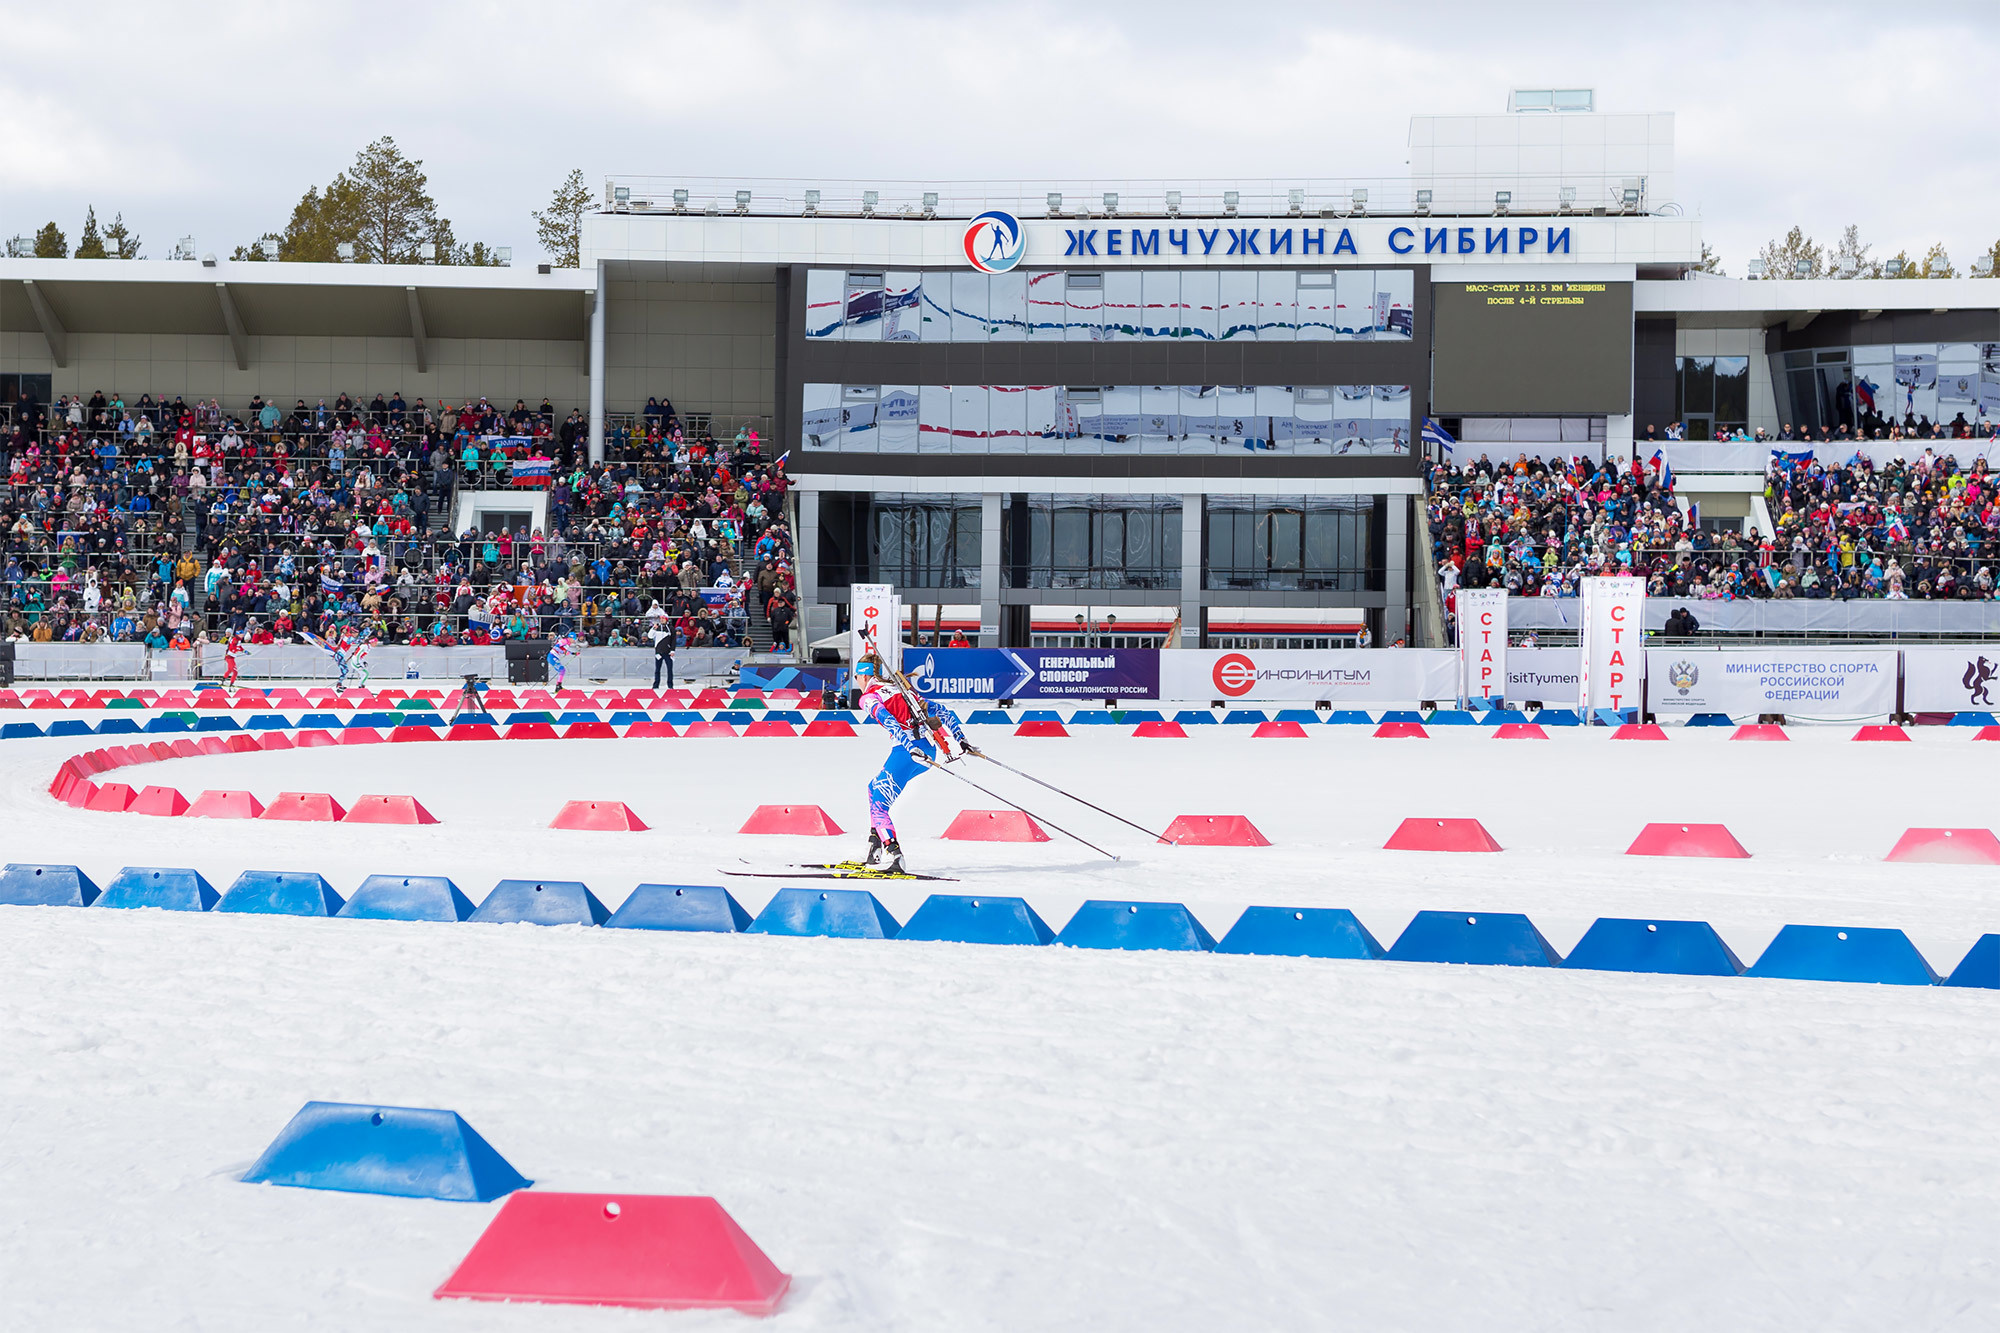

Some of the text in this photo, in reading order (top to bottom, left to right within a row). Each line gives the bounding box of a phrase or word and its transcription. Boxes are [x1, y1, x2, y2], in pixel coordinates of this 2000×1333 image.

[1064, 227, 1570, 256] ЖЕМЧУЖИНА СИБИРИ
[1465, 284, 1606, 292] МАСС-СТАРТ 12.5 КМ ЖЕНЩИНЫ
[1487, 296, 1585, 305] ПОСЛЕ 4-Й СТРЕЛЬБЫ
[1480, 612, 1493, 698] СТАРТ
[1609, 605, 1625, 711] СТАРТ
[1039, 655, 1116, 669] ГЕНЕРАЛЬНЫЙ
[1726, 663, 1879, 674] МИНИСТЕРСТВО СПОРТА
[1039, 670, 1090, 683] СПОНСОР
[1256, 669, 1371, 681] ИНФИНИТУМ
[1508, 672, 1579, 686] isitTyumen
[1760, 675, 1845, 687] РОССИЙСКОЙ
[936, 677, 994, 693] ГАЗПРОМ
[1039, 686, 1148, 694] СОЮЗА БИАТЛОНИСТОВ РОССИИ
[1765, 689, 1840, 702] ФЕДЕРАЦИИ
